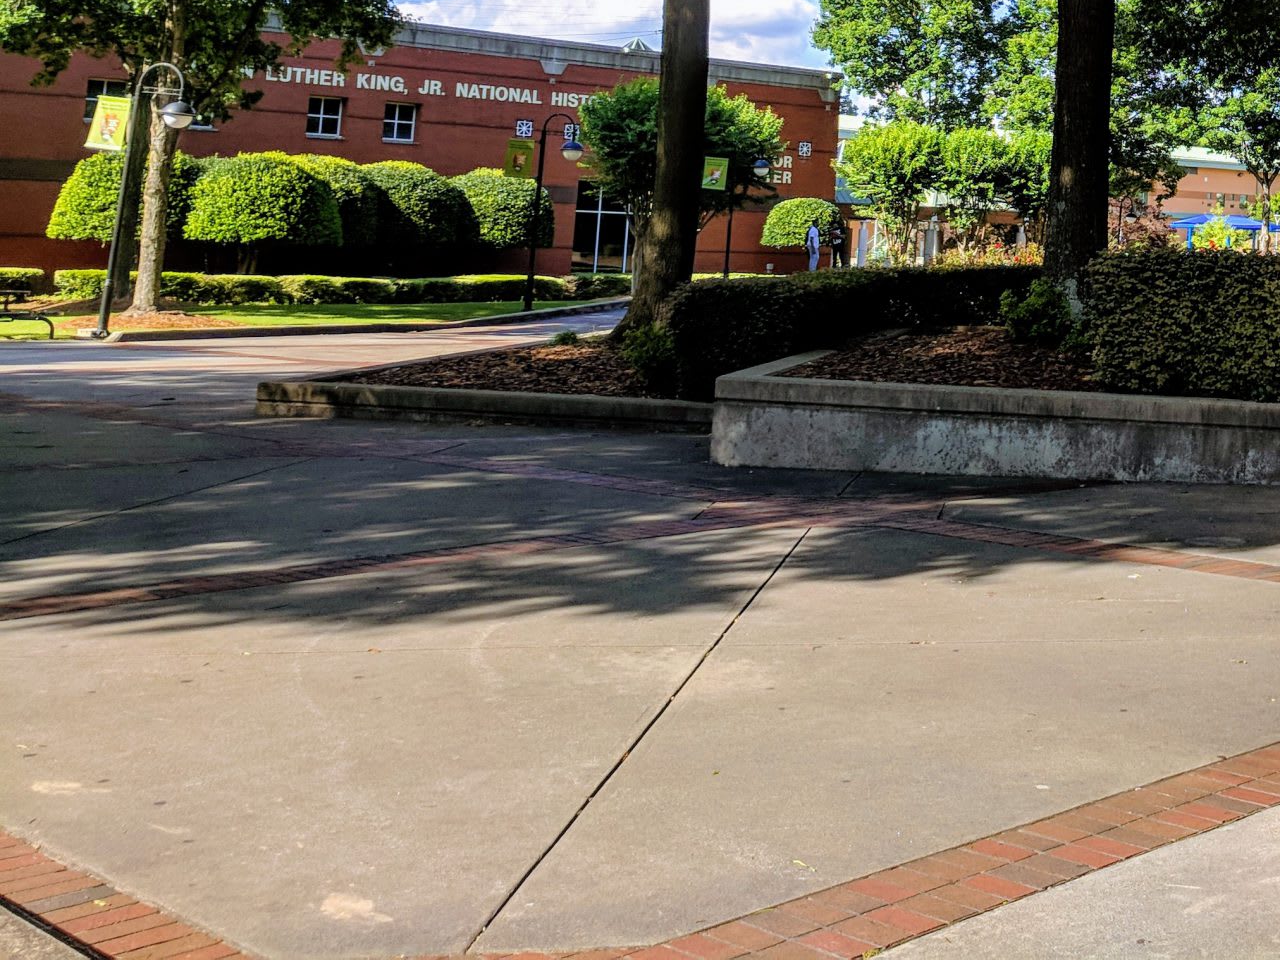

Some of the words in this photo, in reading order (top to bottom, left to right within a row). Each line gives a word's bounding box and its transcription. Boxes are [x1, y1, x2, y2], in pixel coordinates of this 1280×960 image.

[265, 65, 345, 87] LUTHER
[356, 73, 408, 95] KING,
[418, 79, 445, 96] JR.
[455, 82, 543, 104] NATIONAL
